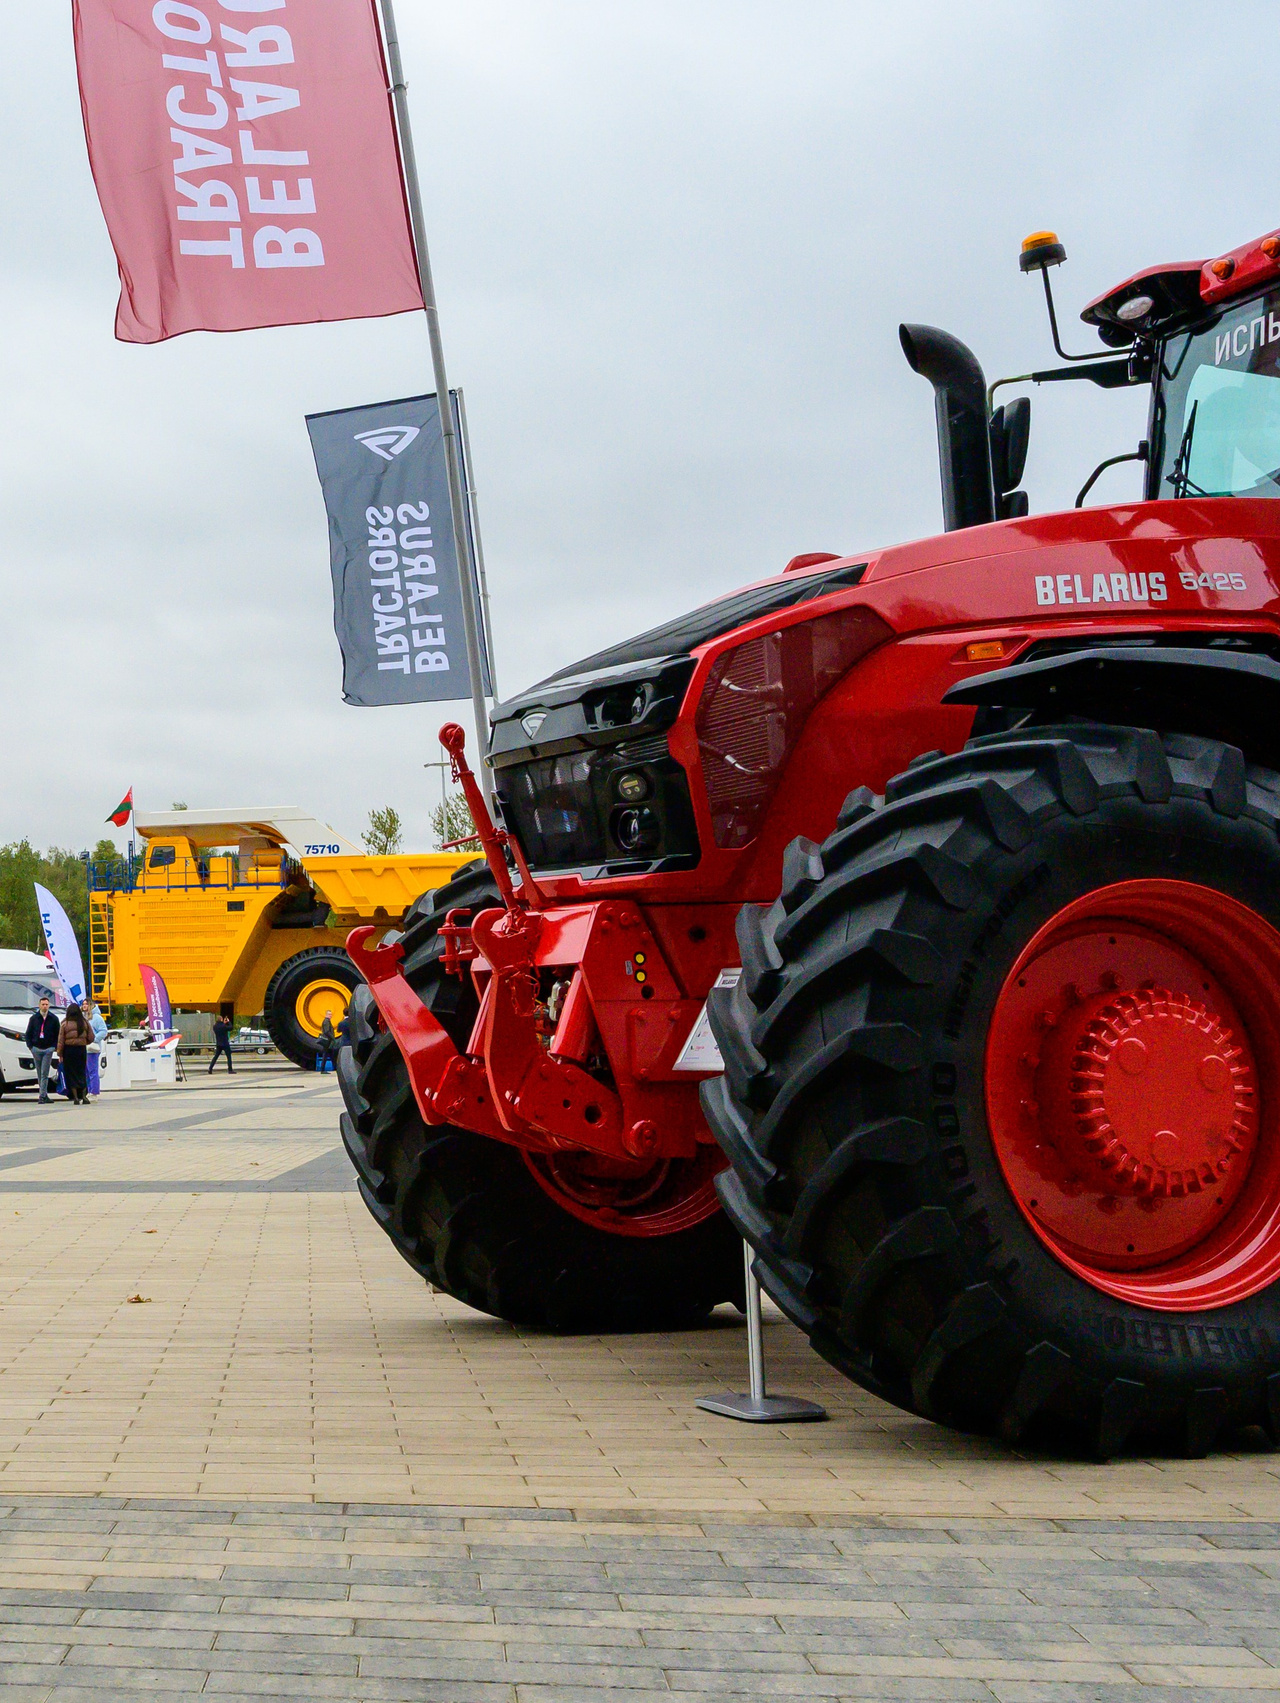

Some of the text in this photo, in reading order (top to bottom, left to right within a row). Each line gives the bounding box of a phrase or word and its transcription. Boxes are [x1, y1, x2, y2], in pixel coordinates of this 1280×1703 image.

[1034, 571, 1248, 606] BELARUS 5425
[304, 844, 340, 855] 75710
